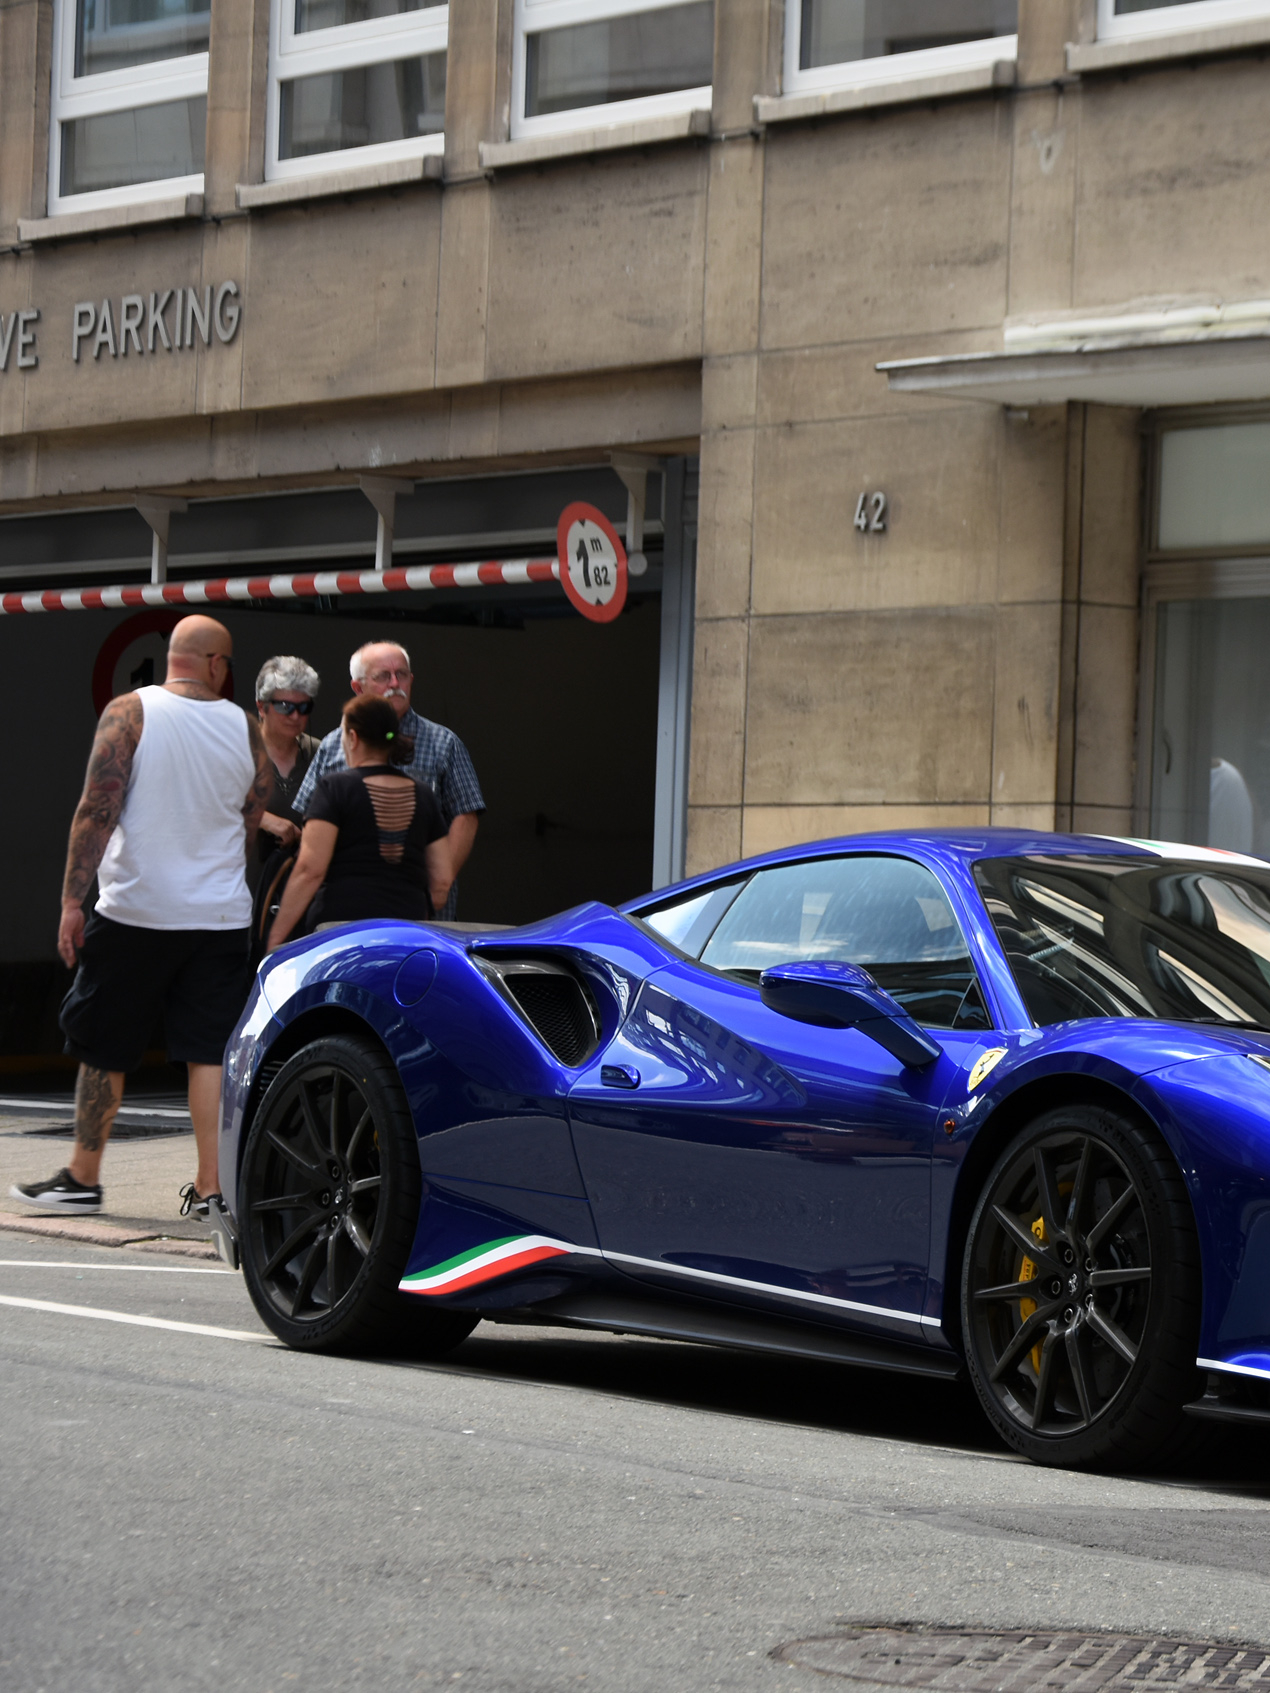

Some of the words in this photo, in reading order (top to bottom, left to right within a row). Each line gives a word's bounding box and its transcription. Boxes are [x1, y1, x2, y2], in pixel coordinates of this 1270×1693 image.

[73, 281, 240, 360] PARKING
[854, 491, 885, 531] 42
[576, 538, 591, 587] 1
[591, 538, 603, 552] m
[593, 566, 611, 586] 82
